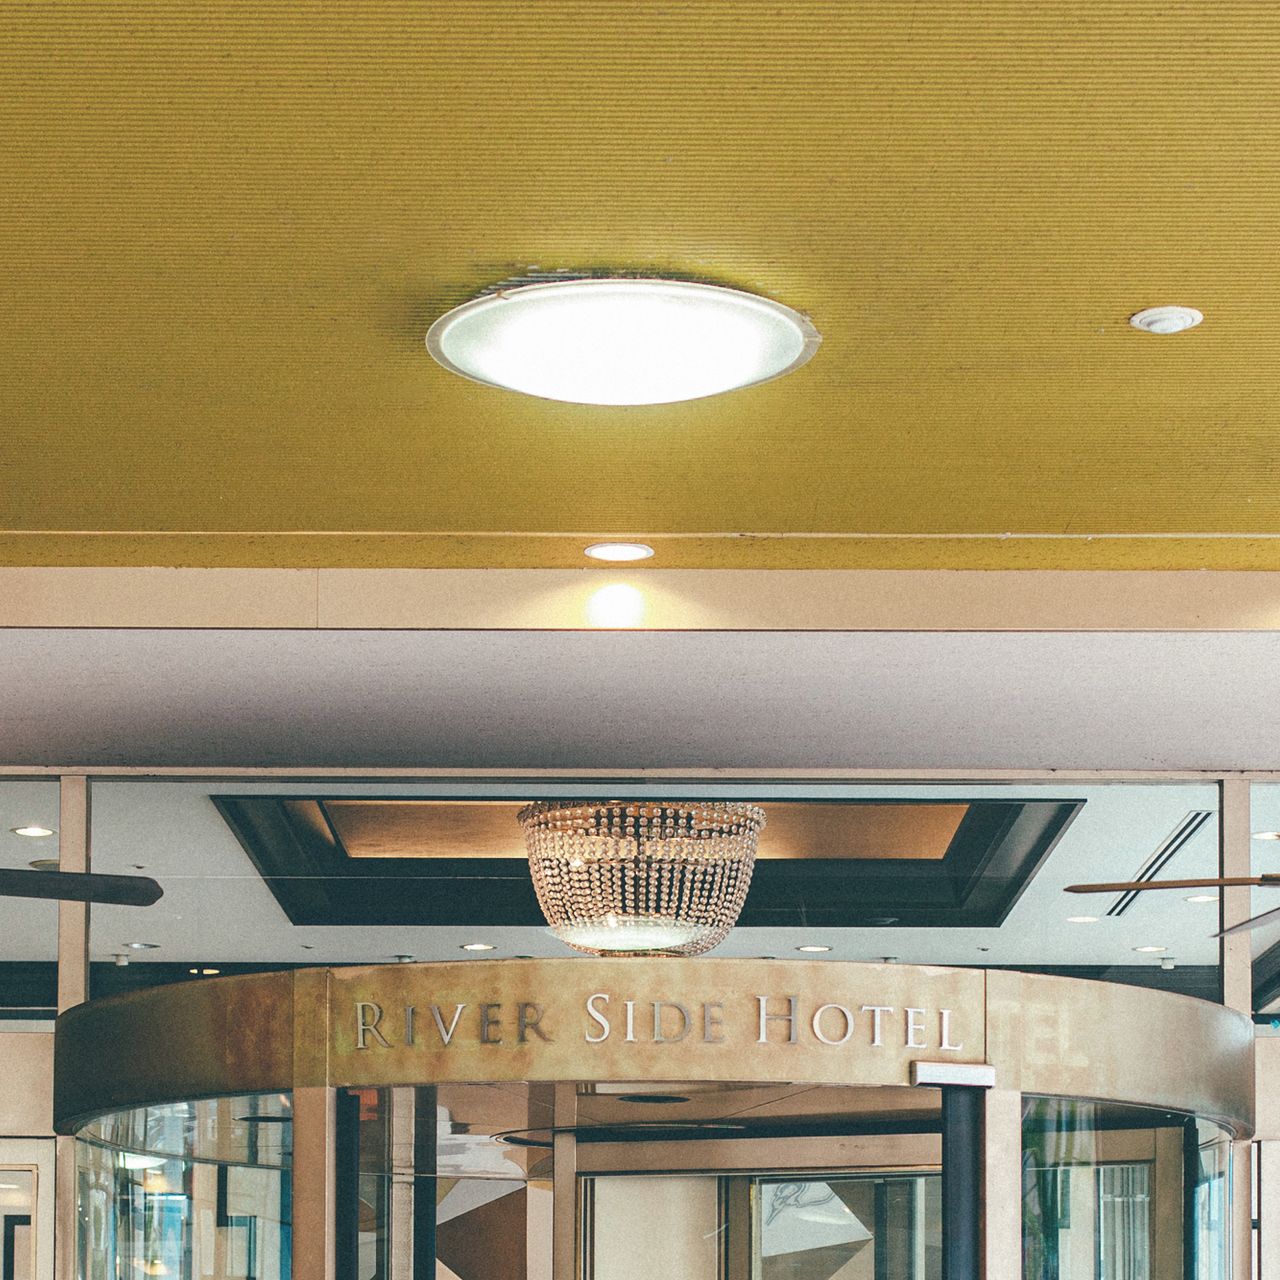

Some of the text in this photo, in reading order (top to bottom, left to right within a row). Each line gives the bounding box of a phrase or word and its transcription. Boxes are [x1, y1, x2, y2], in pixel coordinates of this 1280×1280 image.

[354, 993, 964, 1050] RIVER SIDE HOTEL
